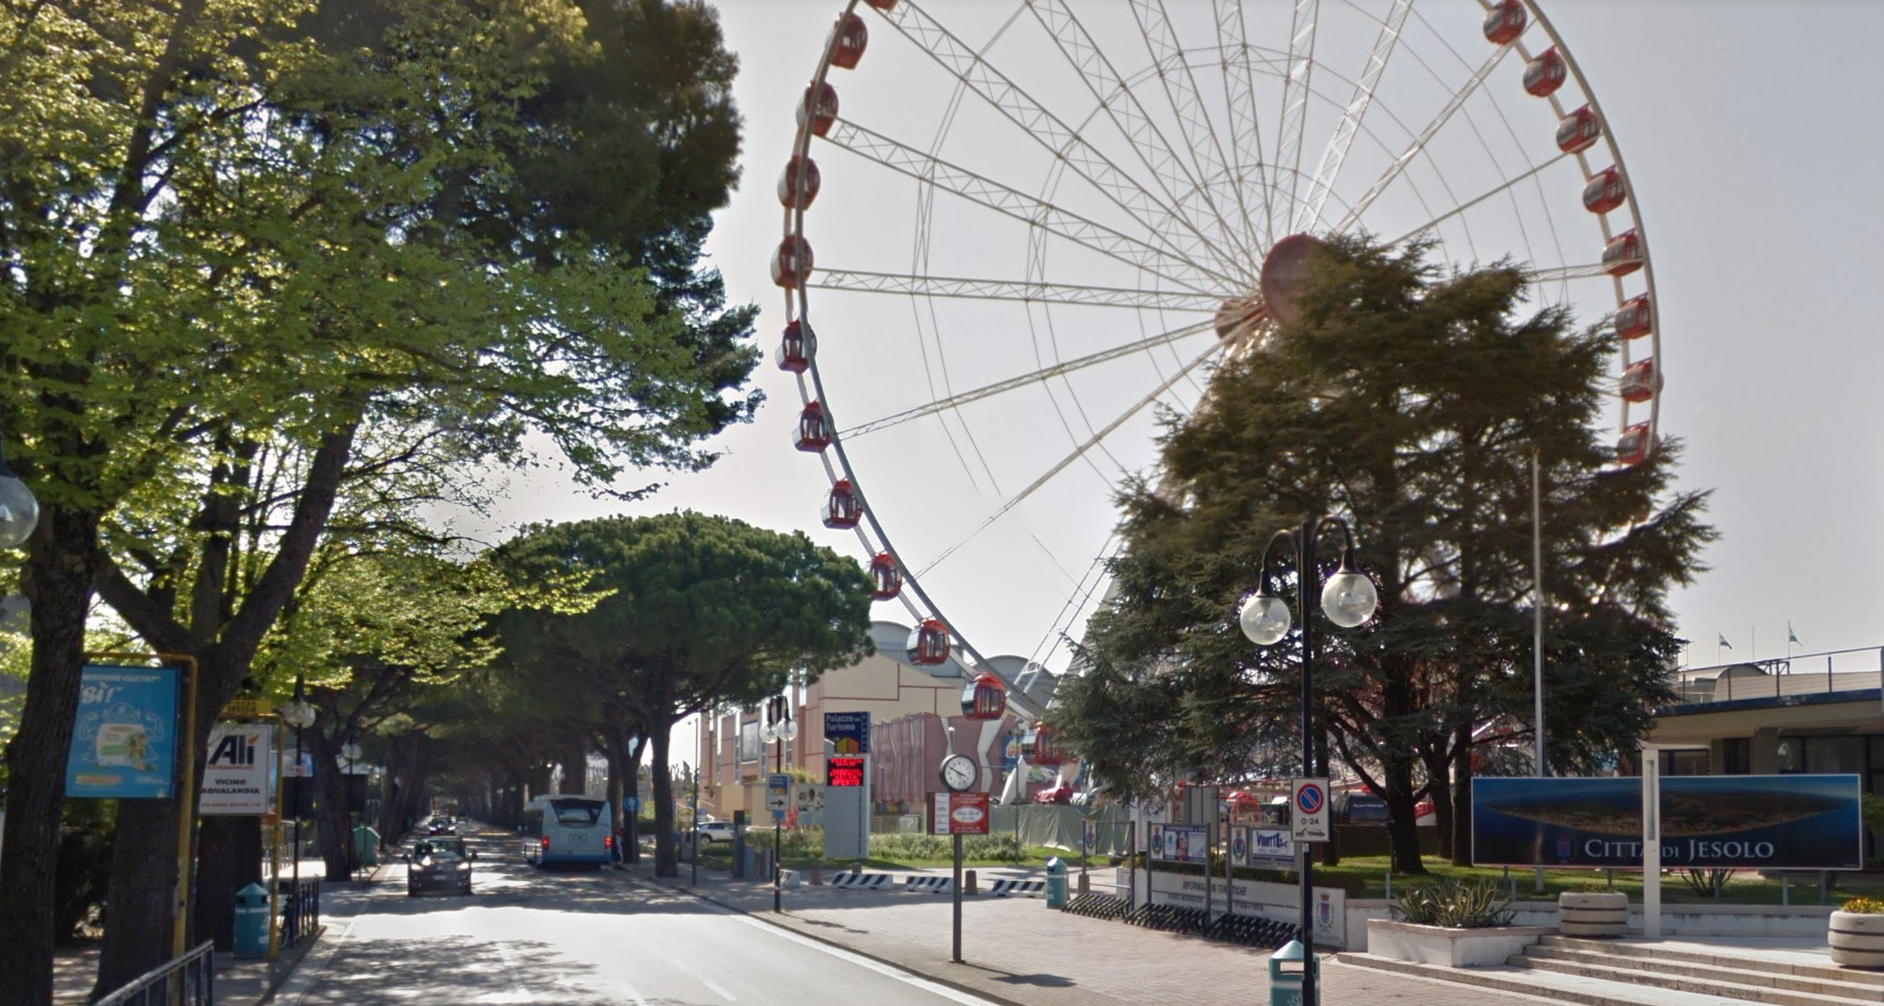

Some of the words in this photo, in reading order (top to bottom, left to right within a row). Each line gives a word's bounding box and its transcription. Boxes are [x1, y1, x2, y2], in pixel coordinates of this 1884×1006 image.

[826, 714, 854, 723] Palazzo
[826, 723, 856, 731] Turismo
[215, 778, 247, 786] VICINO
[201, 787, 260, 795] AQUALANDIA
[1301, 817, 1319, 825] 0-24
